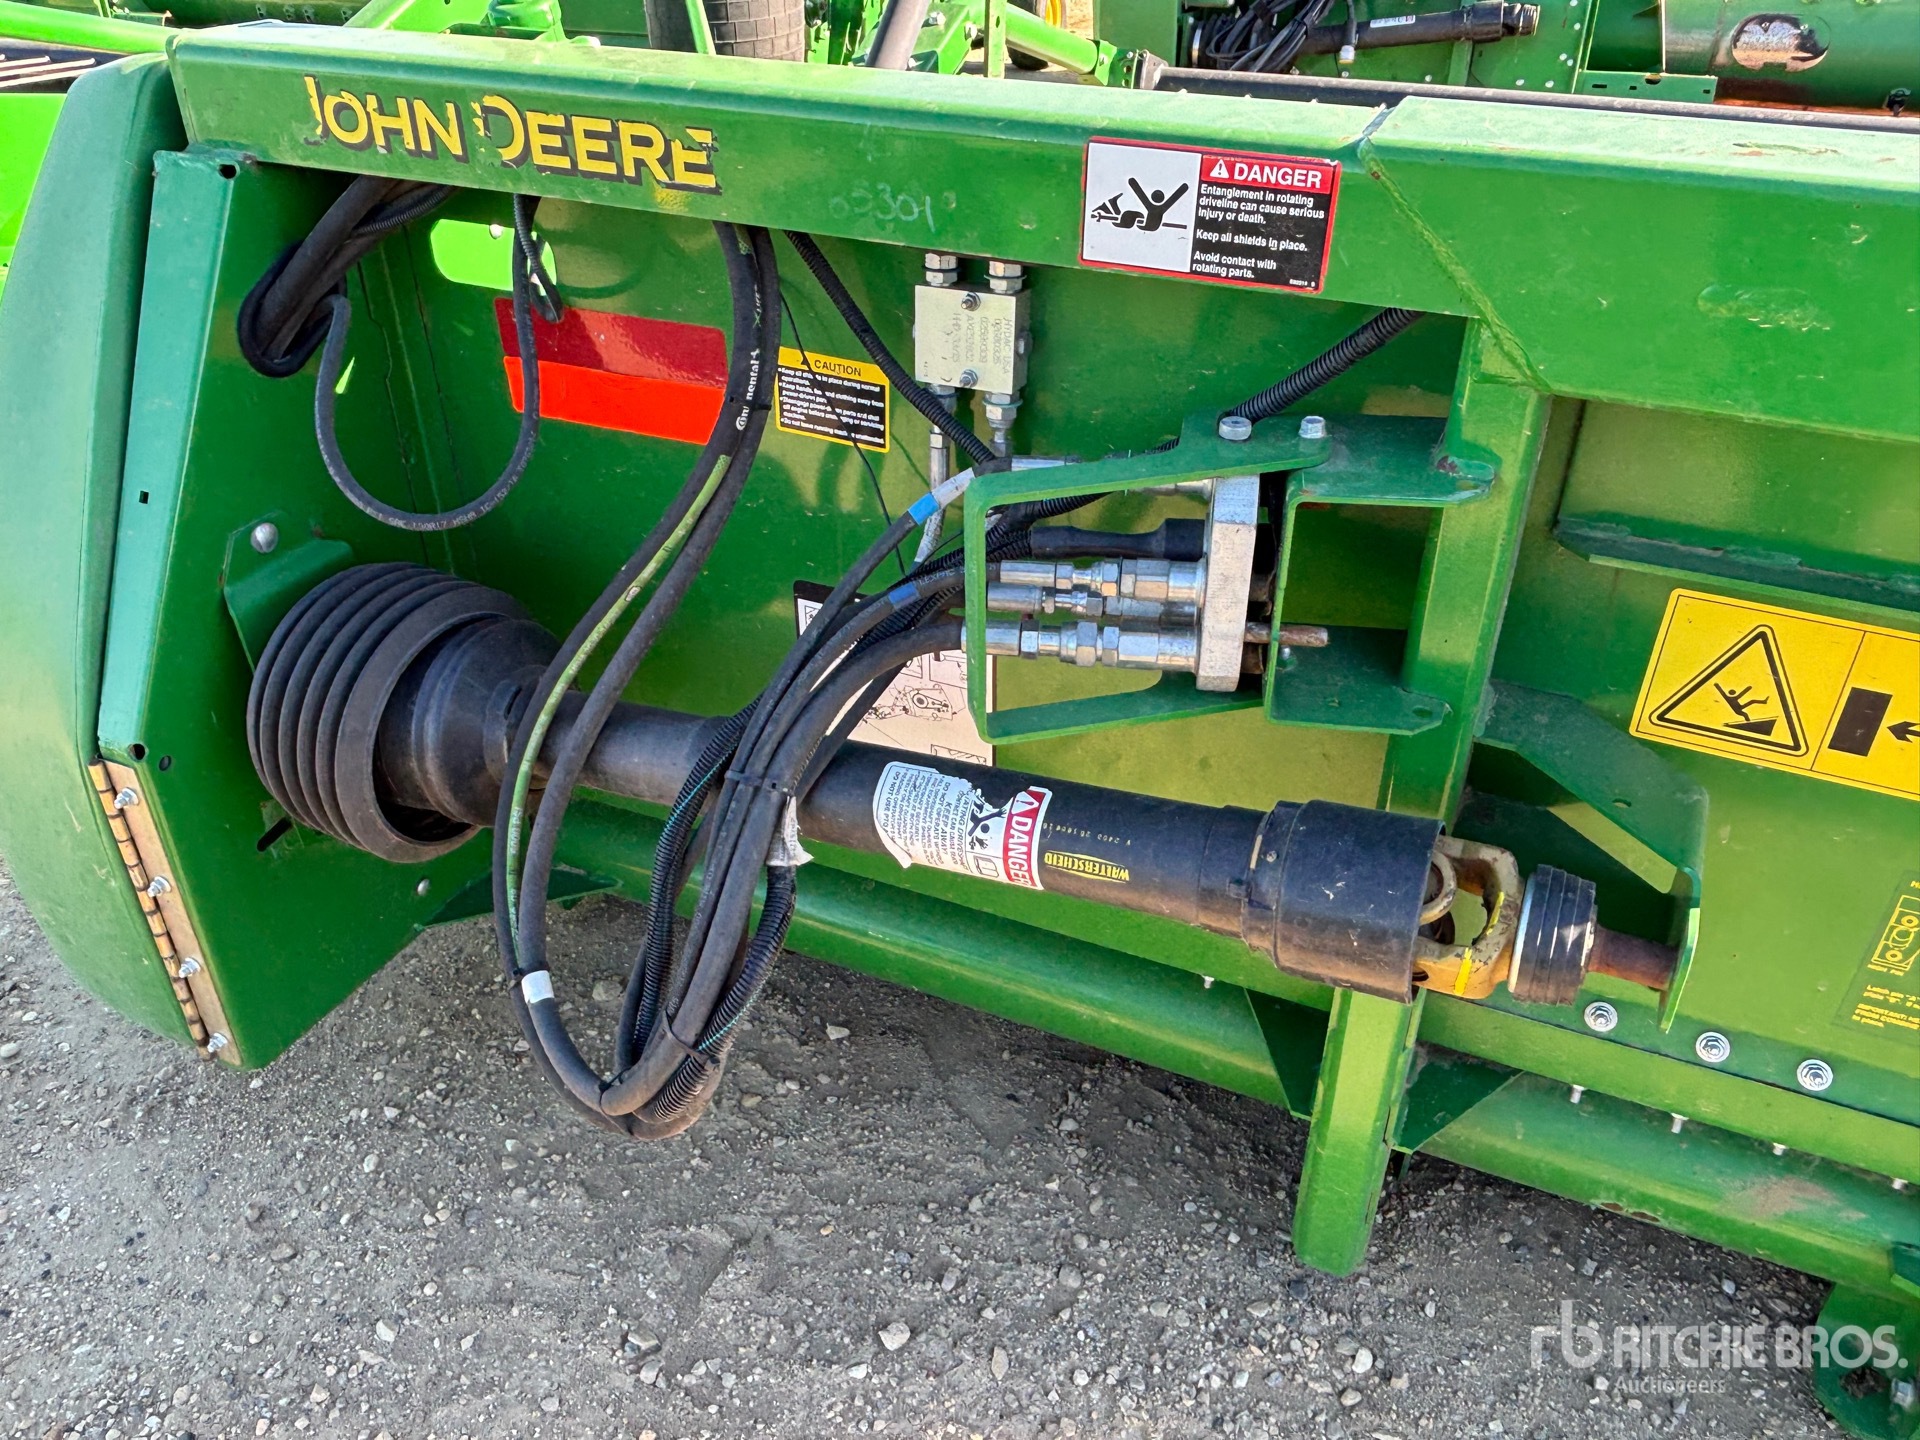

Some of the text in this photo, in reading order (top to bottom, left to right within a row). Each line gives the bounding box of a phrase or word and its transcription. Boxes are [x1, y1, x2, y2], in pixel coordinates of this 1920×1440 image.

[304, 74, 722, 195] JOHN DEERE
[1234, 162, 1322, 189] DANGER
[1199, 196, 1325, 219] driveline can cause serious
[1201, 184, 1314, 208] Entanglement in rotating
[1226, 212, 1236, 220] or
[1237, 212, 1266, 224] death.
[1196, 229, 1307, 251] Keep all shields in place.
[1192, 263, 1254, 278] rotating parts.
[1194, 251, 1276, 269] Avoid contact with
[1003, 318, 1012, 374] HYDAC USA
[814, 360, 861, 376] CAUTION
[888, 782, 897, 796] NOT
[943, 782, 951, 791] DO
[941, 801, 952, 828] KEEP
[1007, 816, 1033, 886] DANGER
[1044, 852, 1130, 881] WALTERSCHEID
